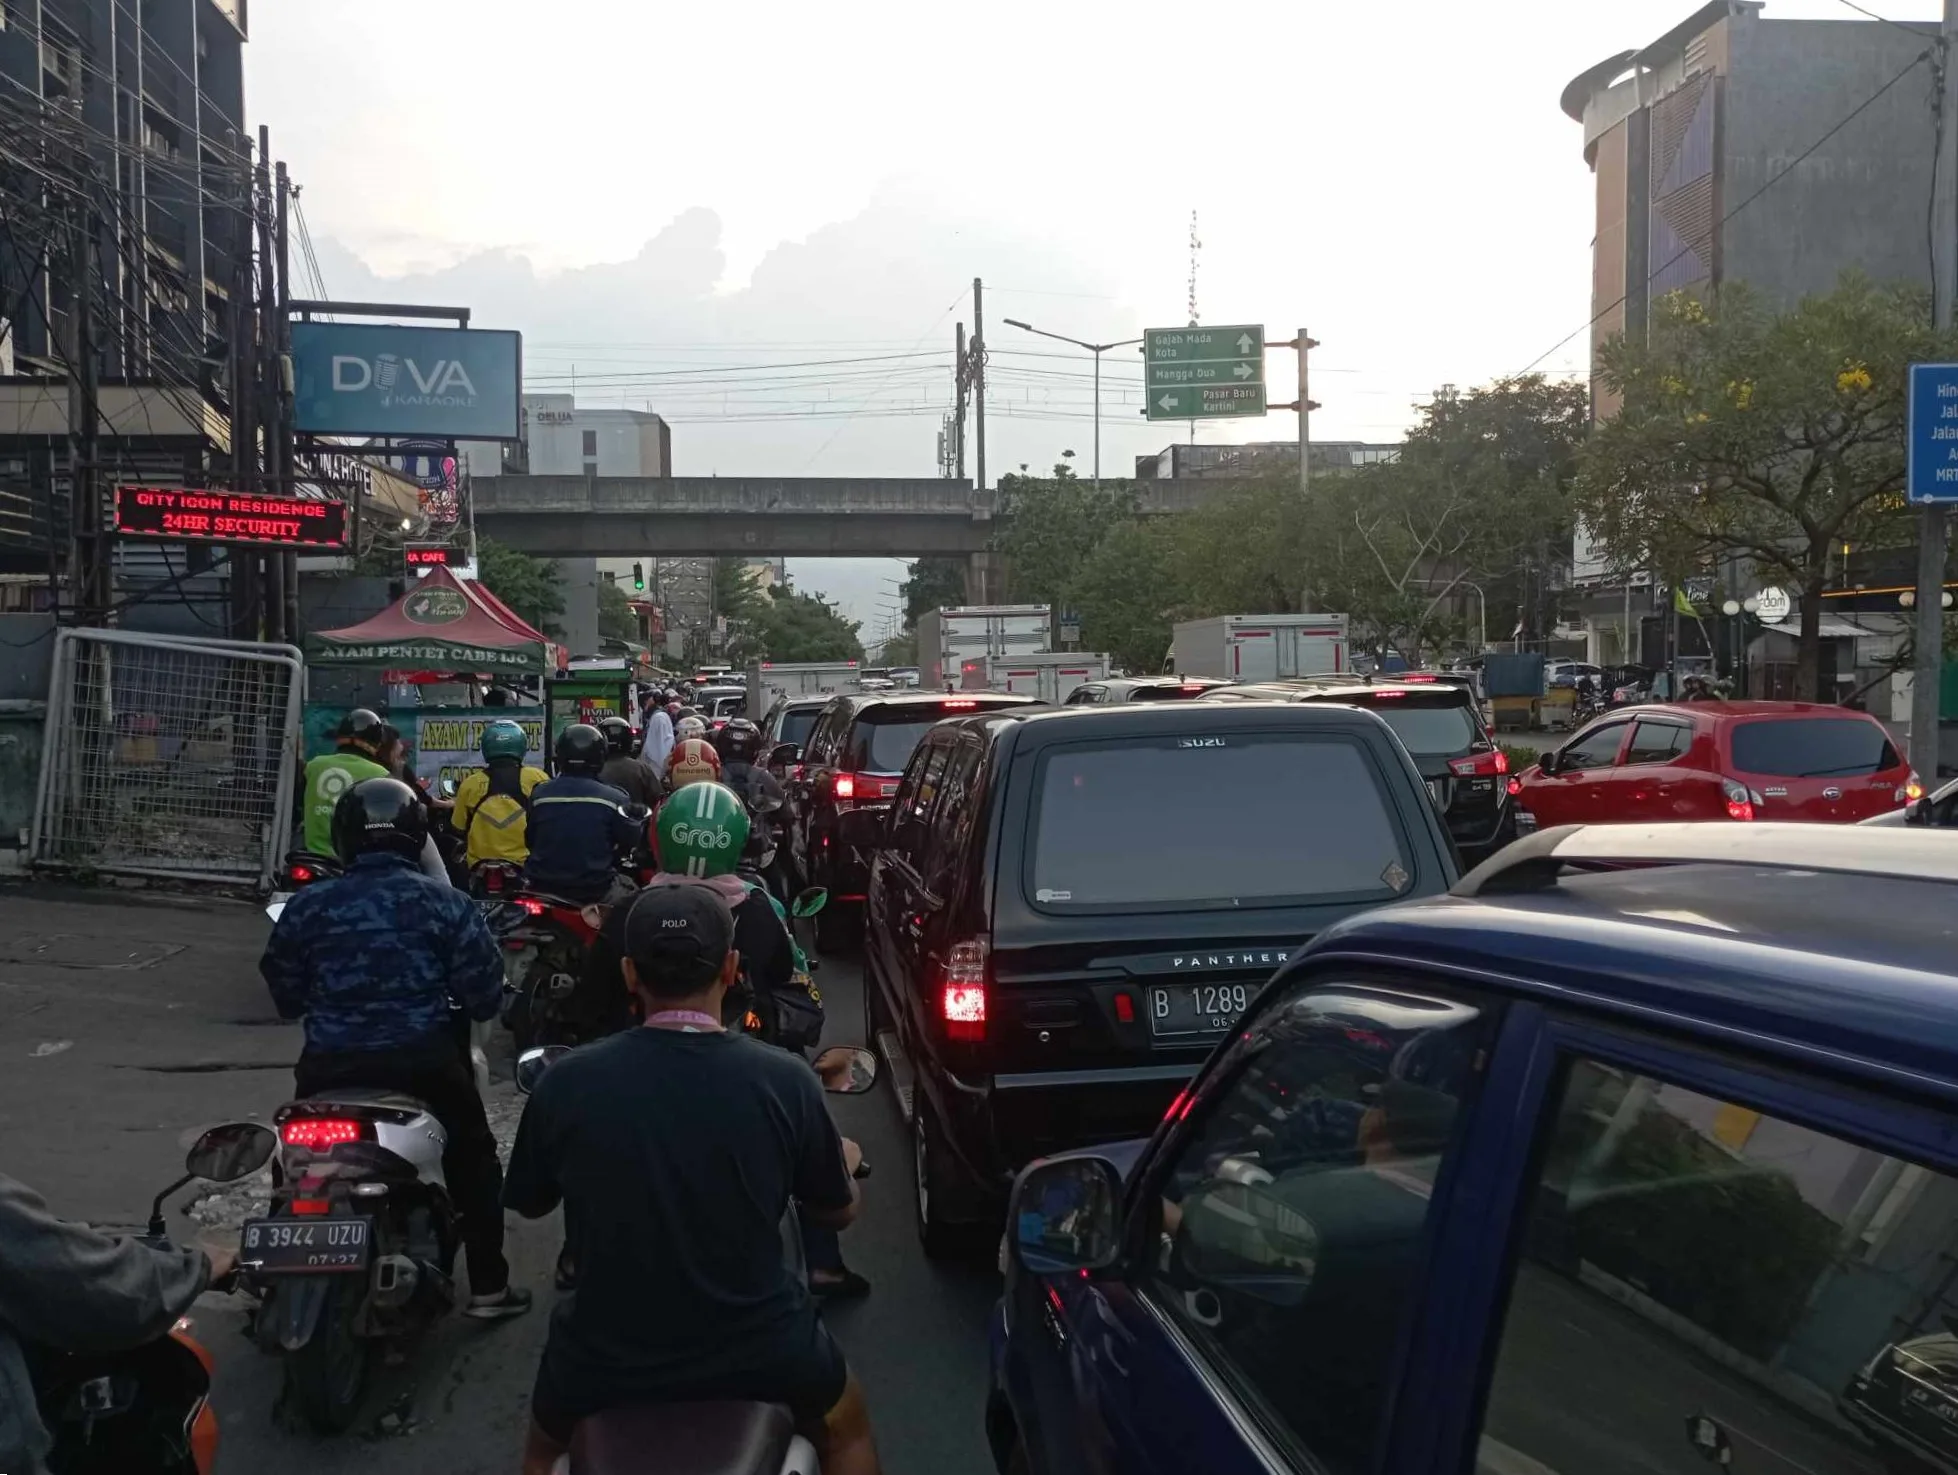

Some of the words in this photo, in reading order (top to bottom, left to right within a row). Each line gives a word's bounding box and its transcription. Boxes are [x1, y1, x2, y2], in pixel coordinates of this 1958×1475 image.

[1155, 334, 1184, 346] Gajah
[1186, 333, 1212, 344] Mada
[1155, 347, 1177, 358] Kota
[1155, 368, 1193, 381] Mangga
[1196, 368, 1216, 378] Dua
[1203, 389, 1229, 399] Pasar
[1233, 388, 1256, 399] Baru
[1937, 383, 1958, 398] Hin
[395, 394, 477, 408] KARAOKE
[1203, 400, 1236, 412] Kartini
[1940, 404, 1958, 419] Jal
[1948, 447, 1958, 461] A
[136, 492, 175, 508] CITY
[180, 495, 223, 510] ICON
[229, 499, 327, 518] RESIDENCE
[162, 513, 210, 530] 24HR
[214, 518, 302, 537] SECURITY
[421, 552, 447, 562] CAFE
[321, 646, 374, 659] AYAM
[376, 646, 447, 660] PENYET
[451, 648, 498, 663] CABE
[420, 720, 469, 752] AYAM
[364, 822, 396, 830] HONDA
[671, 822, 732, 849] Grab
[661, 919, 687, 928] POLO
[1173, 953, 1289, 967] PANTHER
[1154, 990, 1169, 1017] B
[1192, 985, 1248, 1015] 1289
[247, 1227, 261, 1248] B
[268, 1226, 314, 1247] 3944
[327, 1225, 364, 1246] UZU
